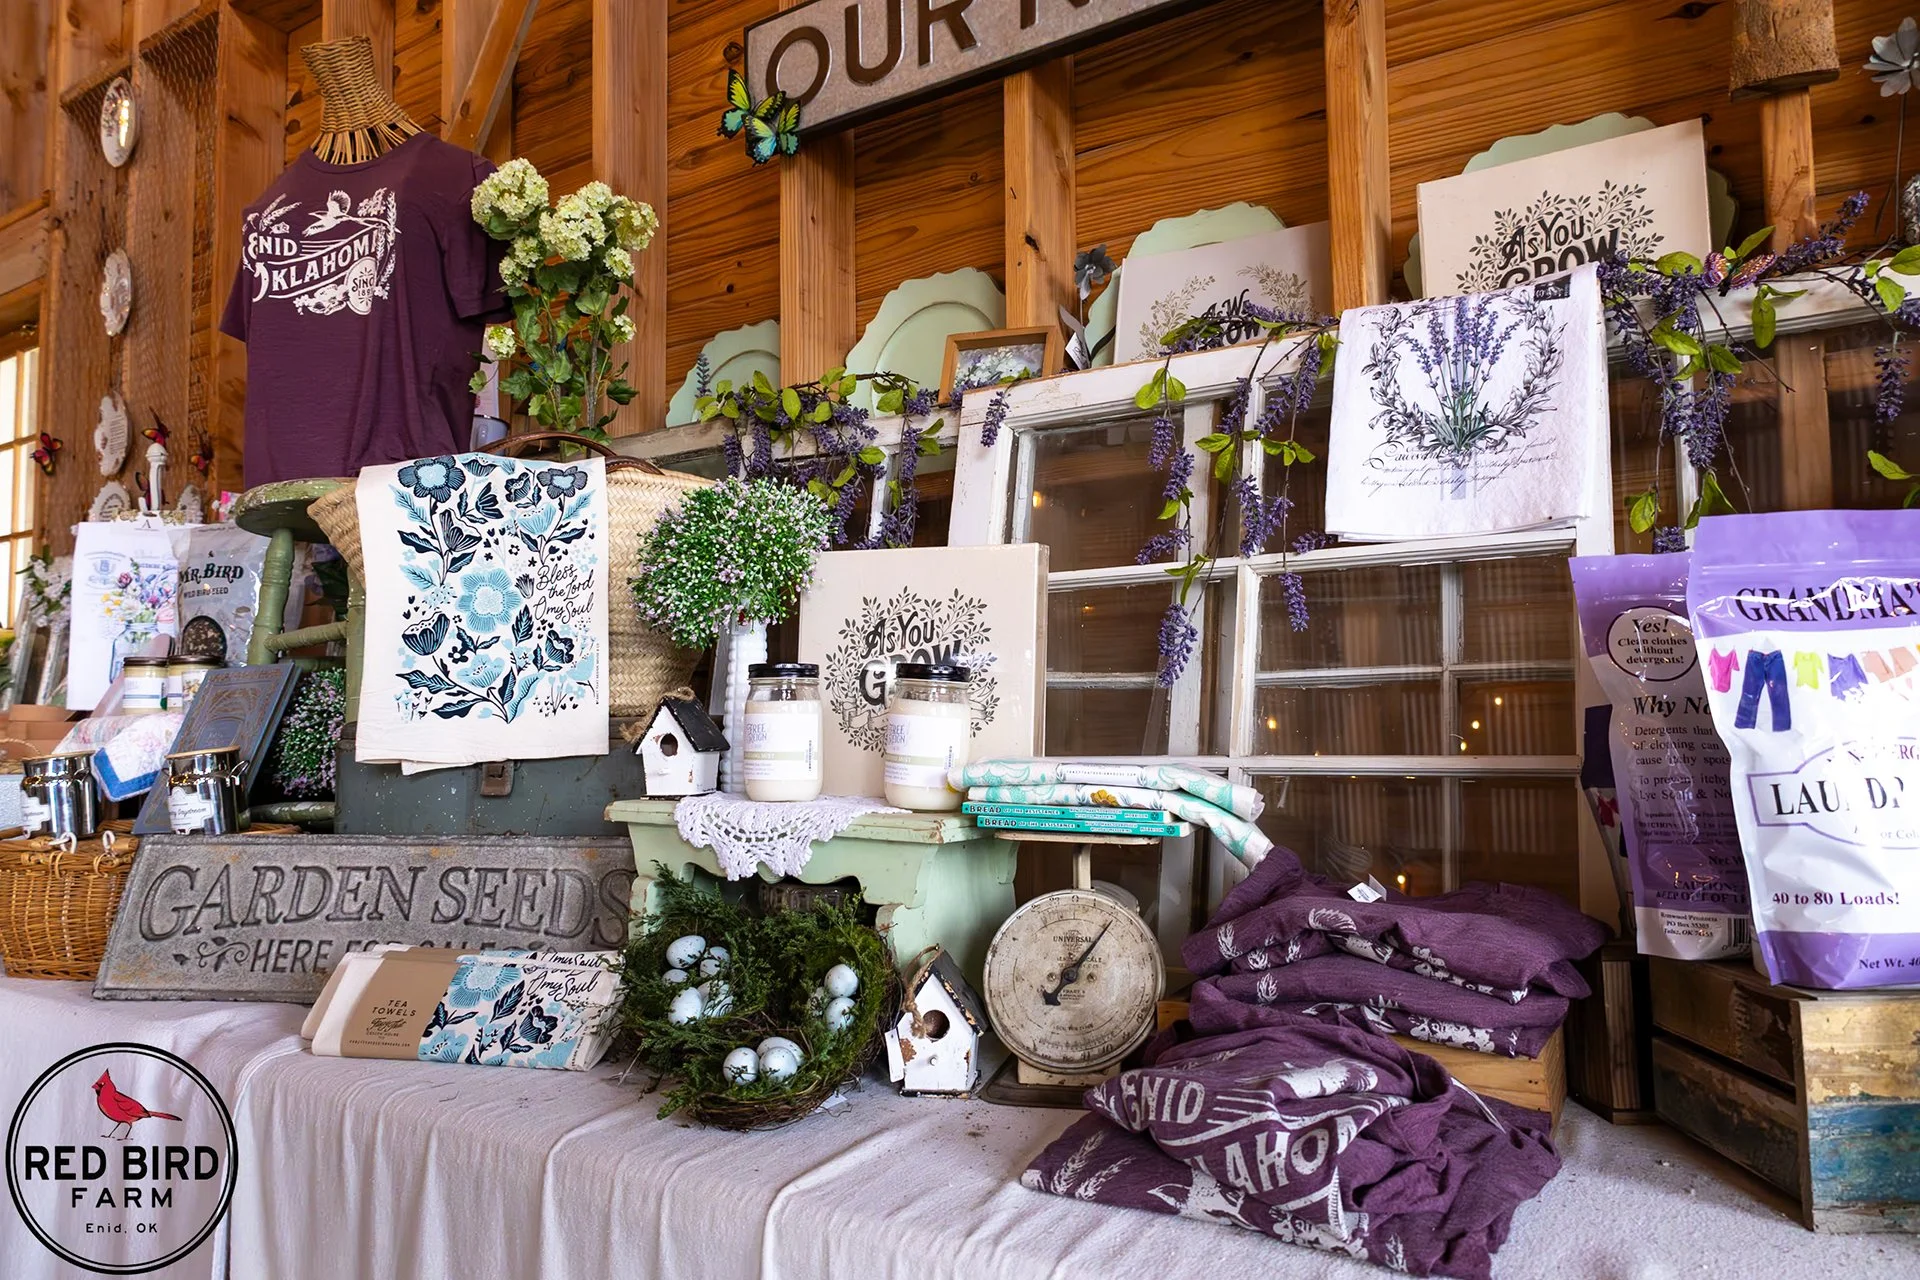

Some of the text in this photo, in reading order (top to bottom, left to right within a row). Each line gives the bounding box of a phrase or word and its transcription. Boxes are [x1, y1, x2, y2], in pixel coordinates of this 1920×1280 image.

[766, 0, 979, 106] OUR
[248, 232, 298, 259] ENID
[252, 228, 377, 302] KLAHOM
[352, 277, 375, 292] SINC
[203, 562, 245, 583] BIRD
[536, 563, 578, 590] Bless
[548, 569, 595, 601] the Lord
[561, 592, 594, 625] Soul
[1632, 618, 1670, 633] Yes!
[1617, 637, 1688, 647] Clean clothes
[1634, 645, 1674, 655] without
[1626, 655, 1685, 665] detergents!
[1633, 695, 1712, 718] Why No
[1635, 725, 1713, 738] Detergents that
[1701, 742, 1720, 750] can
[1635, 756, 1663, 765] cause
[1703, 755, 1732, 766] spots
[1700, 773, 1728, 785] itchy
[1696, 789, 1708, 799] &
[1714, 789, 1732, 799] No
[970, 805, 1002, 813] BREAD
[984, 818, 1017, 827] BREAD
[139, 864, 638, 948] GARDEN SEEDS
[1772, 892, 1900, 906] 40 to 80 Loads!
[249, 940, 333, 974] HERE
[1859, 958, 1880, 969] Net
[1885, 957, 1905, 969] Wt.
[554, 970, 602, 1002] Soul
[388, 999, 408, 1008] TEA
[372, 1006, 417, 1017] TOWELS
[1119, 1071, 1206, 1131] ENID
